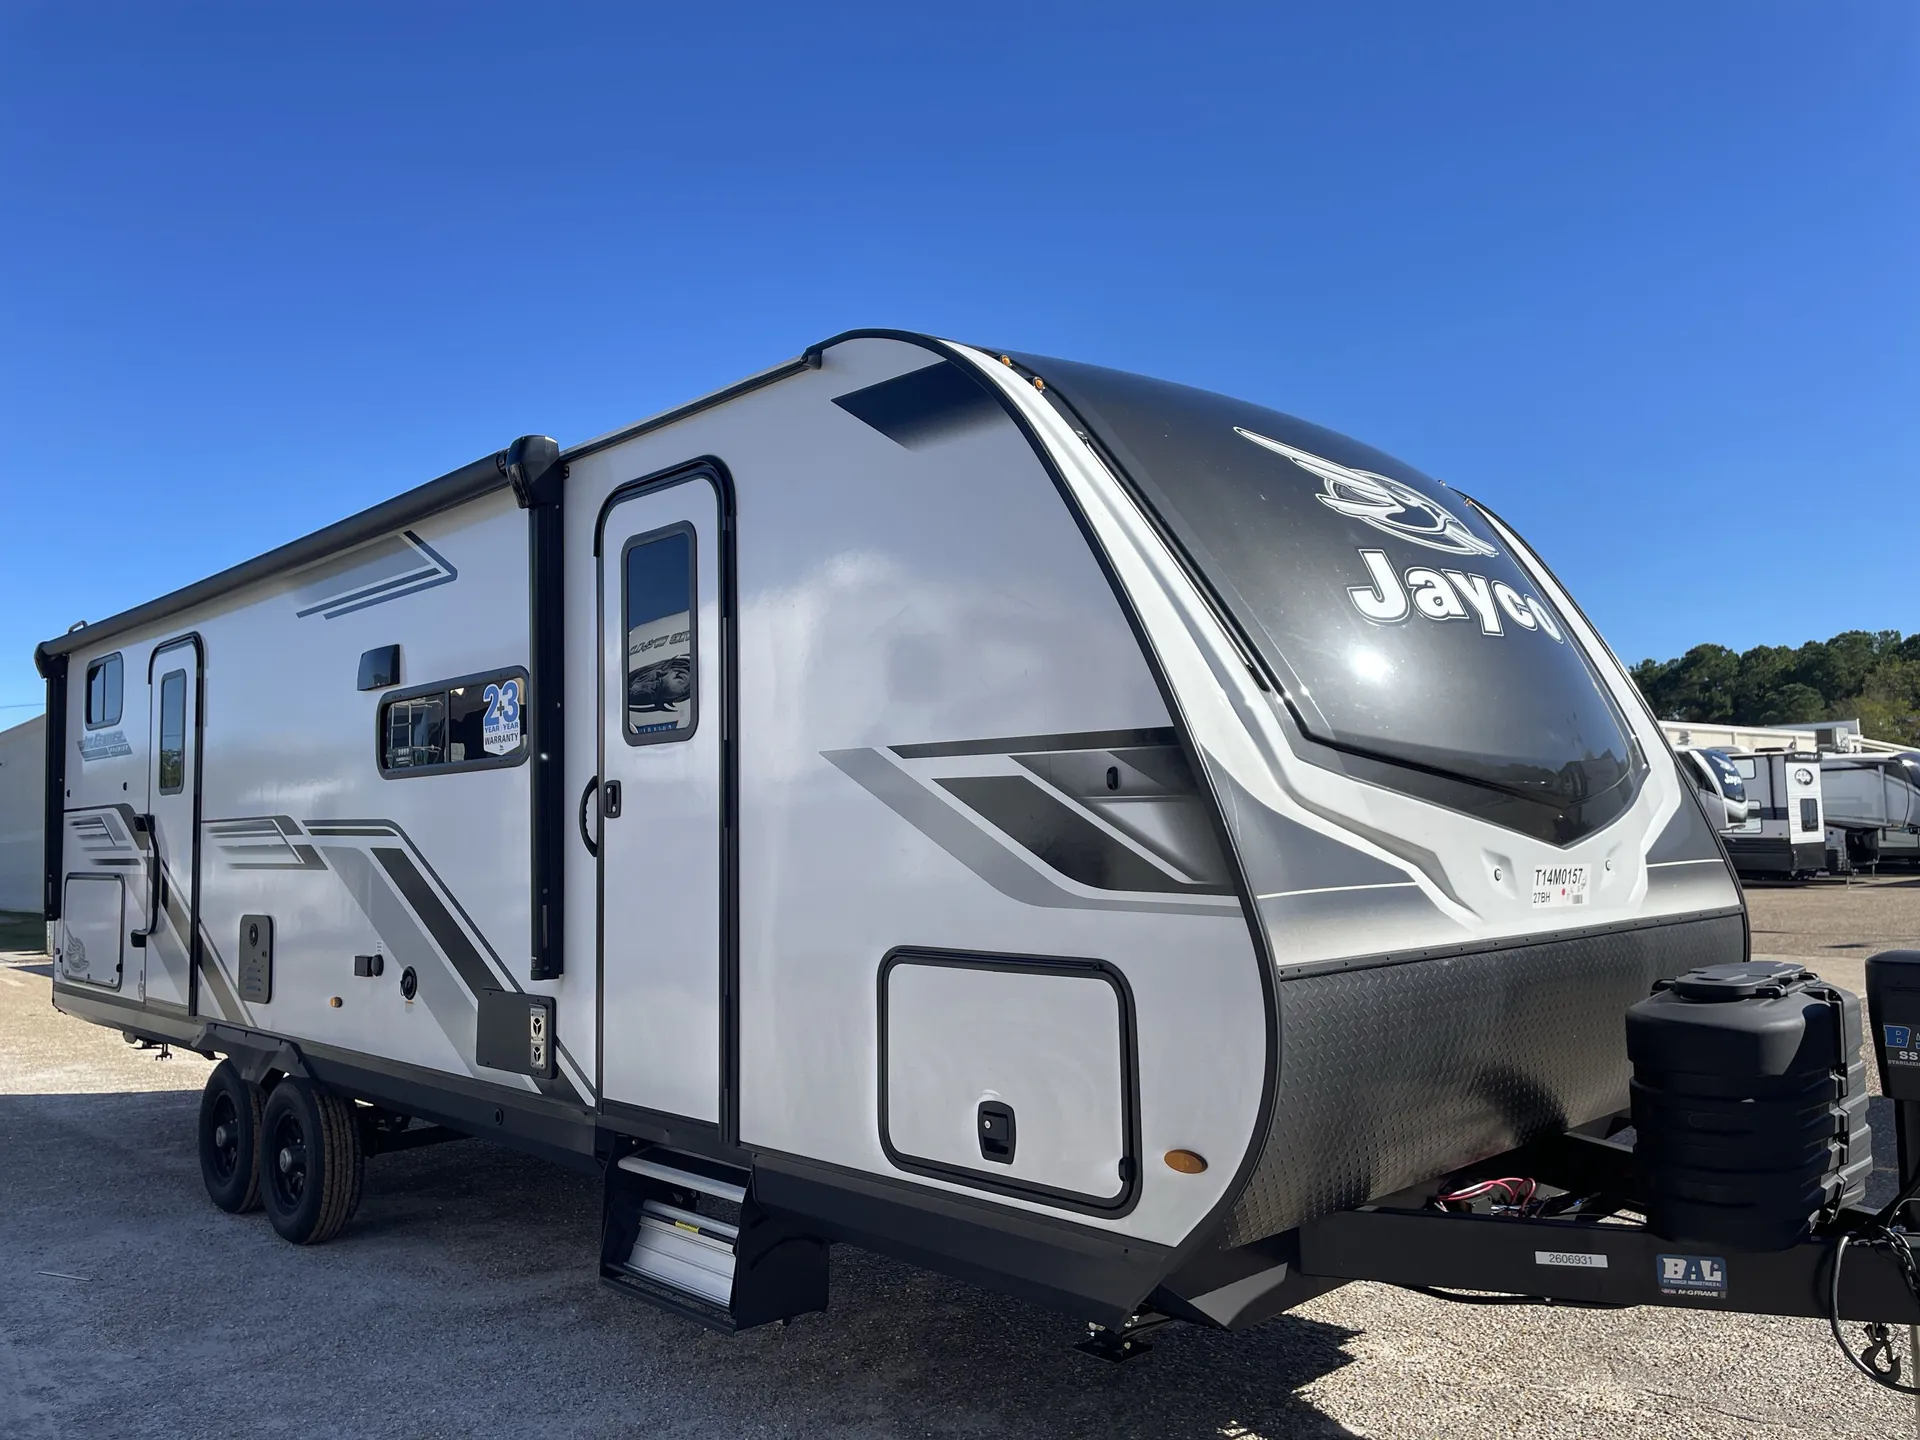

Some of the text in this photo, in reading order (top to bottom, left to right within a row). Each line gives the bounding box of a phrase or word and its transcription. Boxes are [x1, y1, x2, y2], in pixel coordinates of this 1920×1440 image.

[1347, 548, 1564, 644] Jayco
[503, 722, 518, 730] YEAR
[485, 733, 518, 745] WARRANTY
[1535, 868, 1583, 886] T14M0157
[1533, 892, 1551, 903] 27BH
[1549, 1253, 1593, 1265] 2606931
